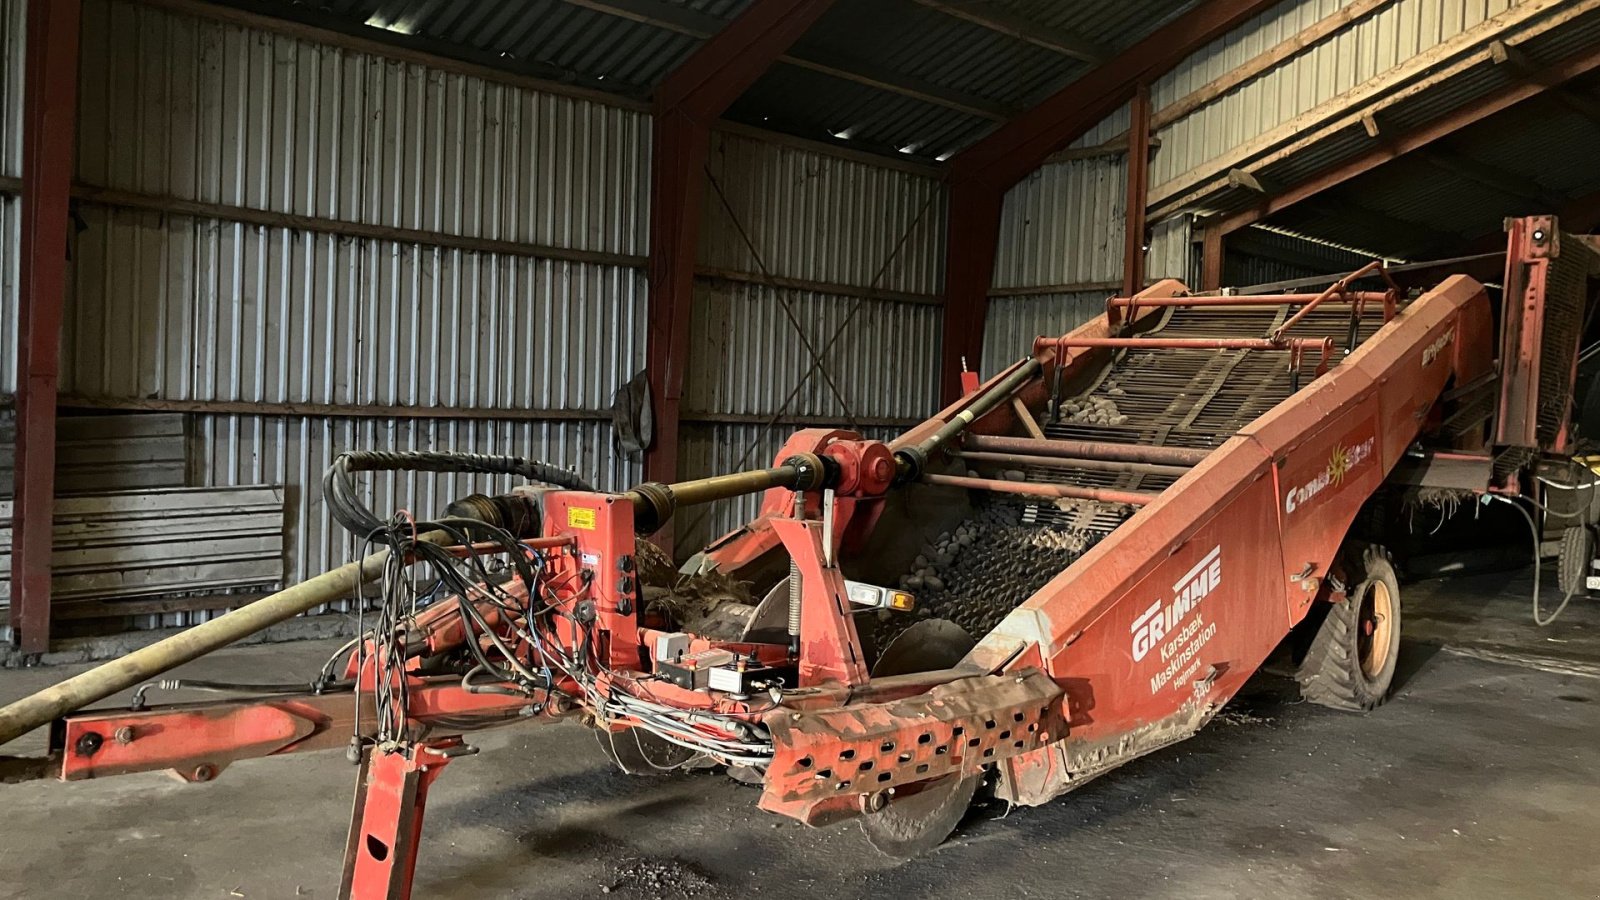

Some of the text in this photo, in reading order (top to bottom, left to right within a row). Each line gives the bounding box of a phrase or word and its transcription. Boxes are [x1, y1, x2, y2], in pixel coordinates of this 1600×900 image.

[1132, 556, 1220, 662] GRIMME
[1160, 613, 1203, 663] Karsbæk
[1150, 622, 1217, 695] Maskinstation
[1173, 658, 1201, 691] Højmark
